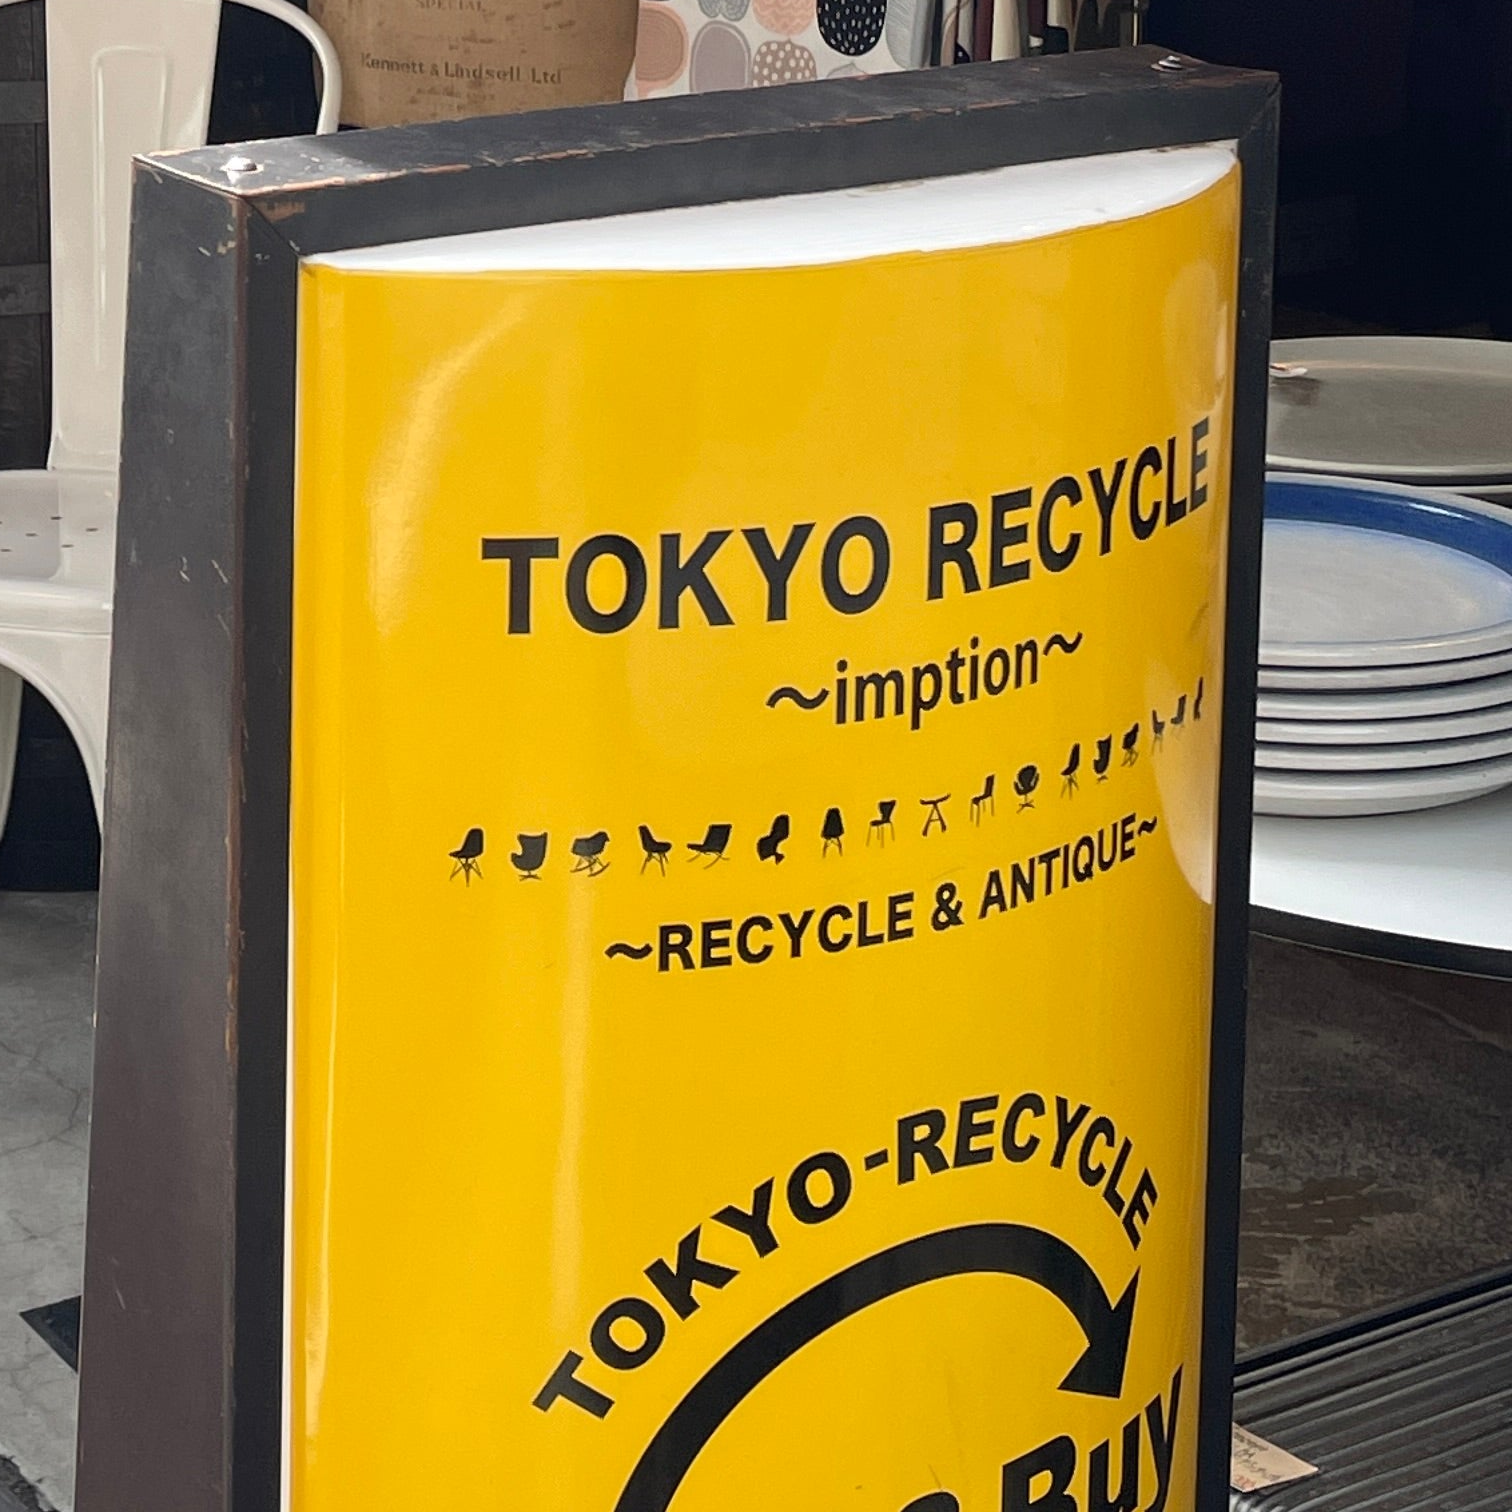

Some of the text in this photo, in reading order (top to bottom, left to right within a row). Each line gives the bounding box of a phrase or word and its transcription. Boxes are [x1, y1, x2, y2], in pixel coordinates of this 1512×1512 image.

[481, 415, 1211, 635] TOKYO RECYCLE
[930, 882, 965, 932] &
[532, 1092, 1160, 1420] TOKYO-RECYCLE
